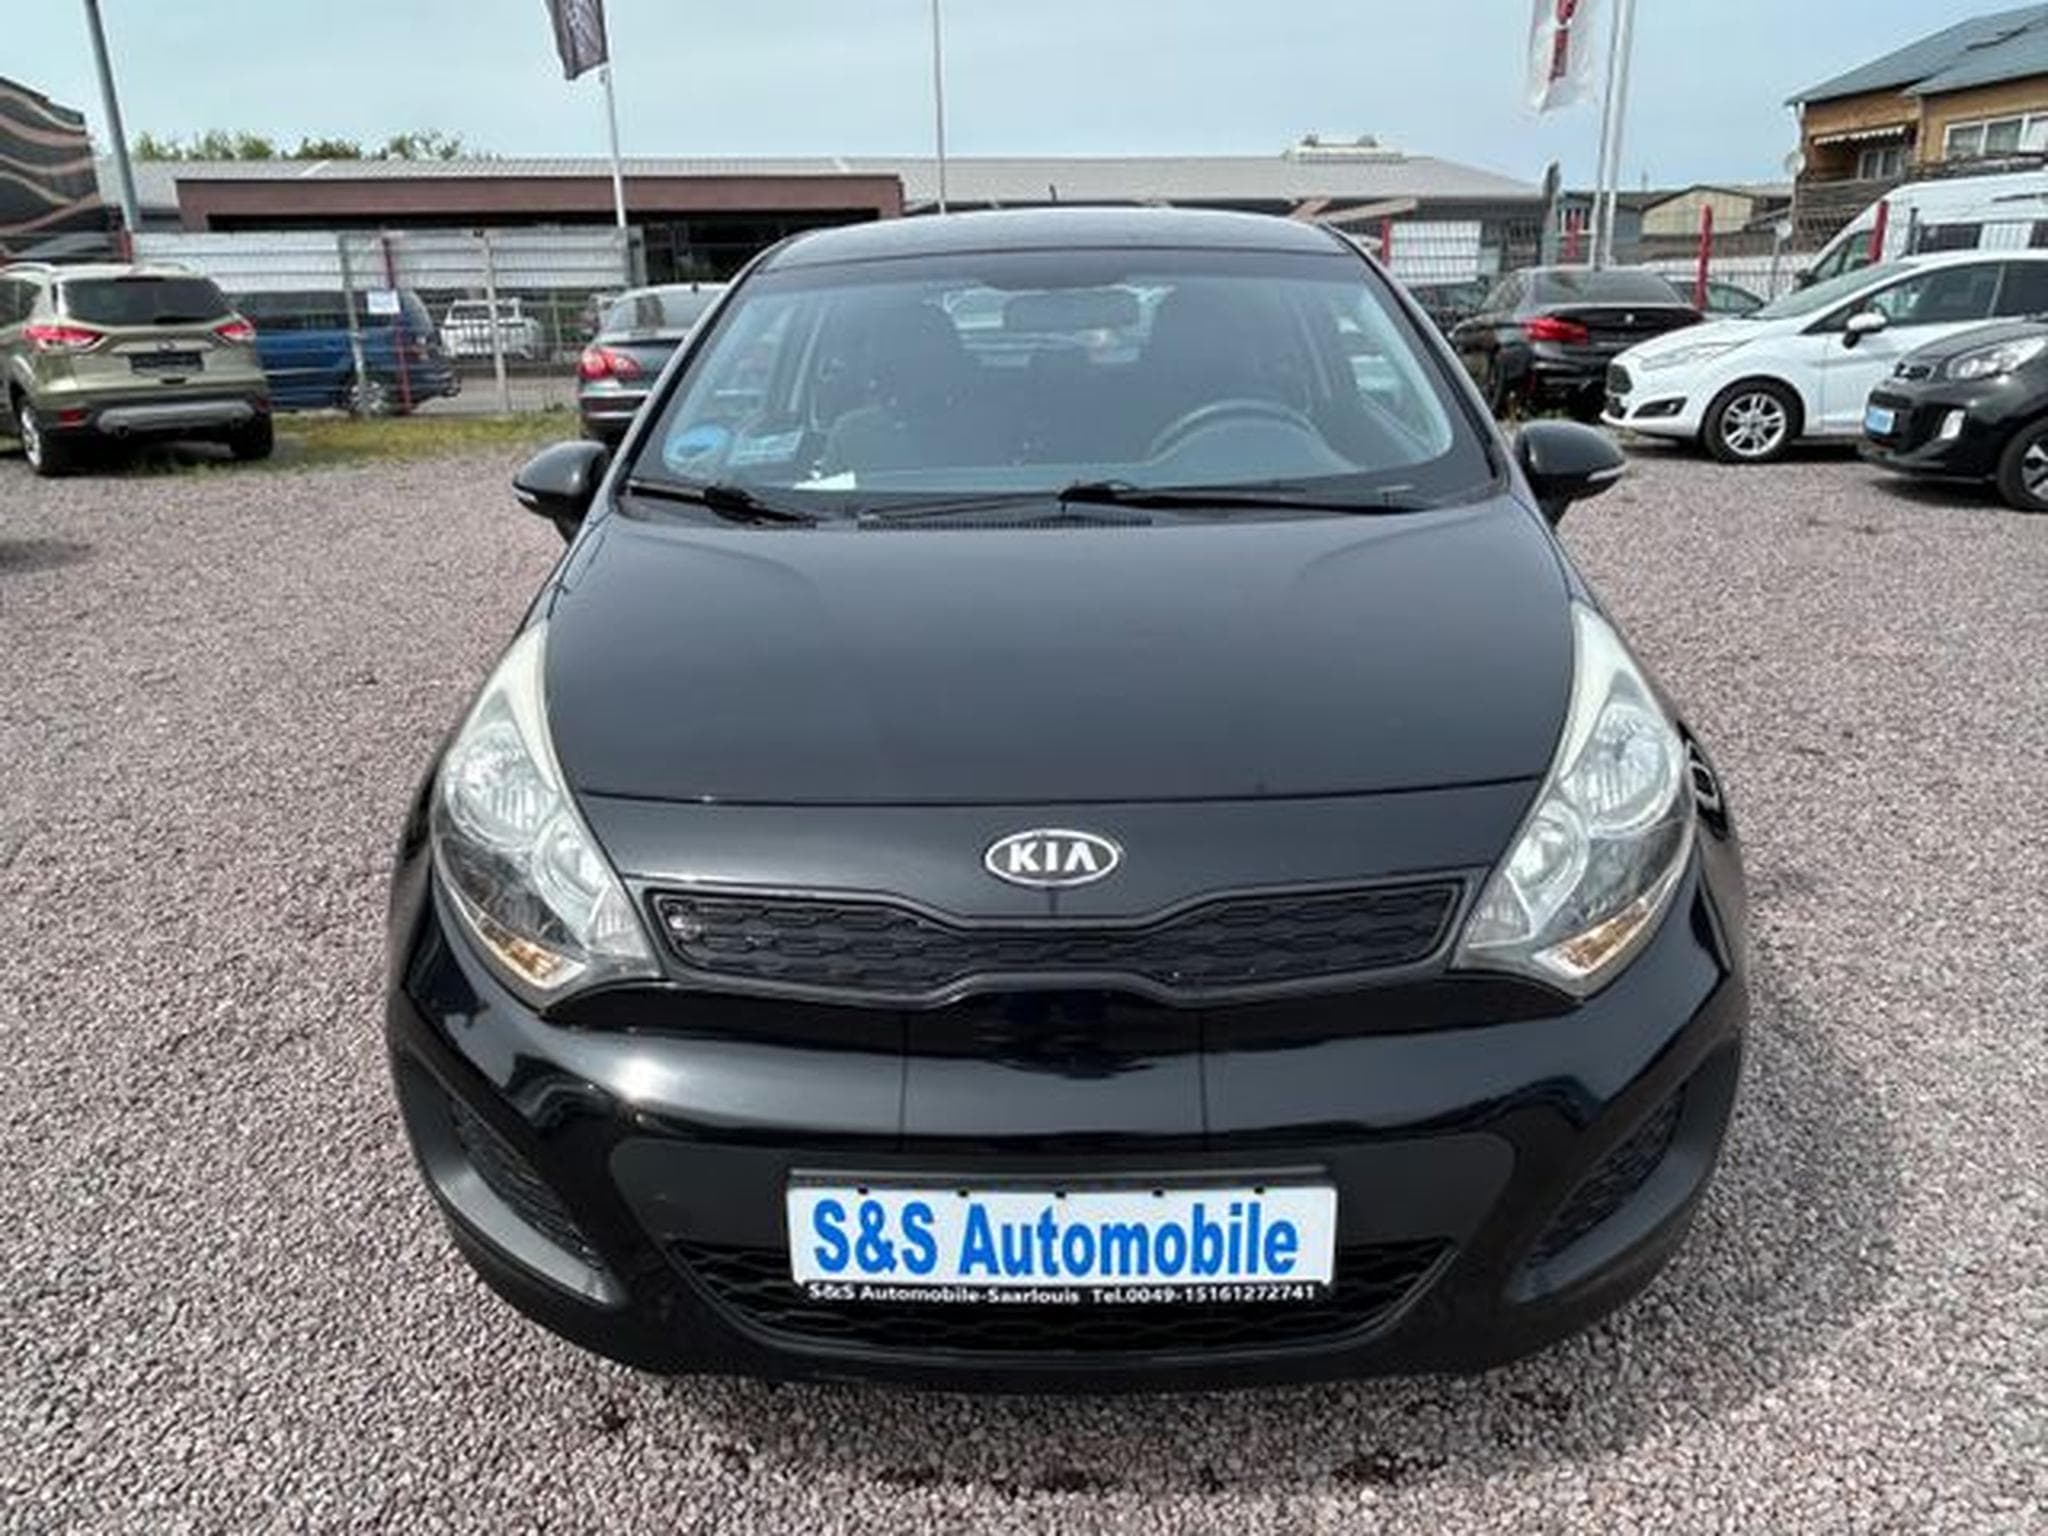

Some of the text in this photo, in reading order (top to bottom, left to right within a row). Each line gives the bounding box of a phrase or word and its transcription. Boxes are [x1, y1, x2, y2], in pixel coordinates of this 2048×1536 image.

[1008, 841, 1098, 872] KIA
[813, 1200, 1298, 1278] S&S Automobile
[808, 1282, 855, 1300] S&S
